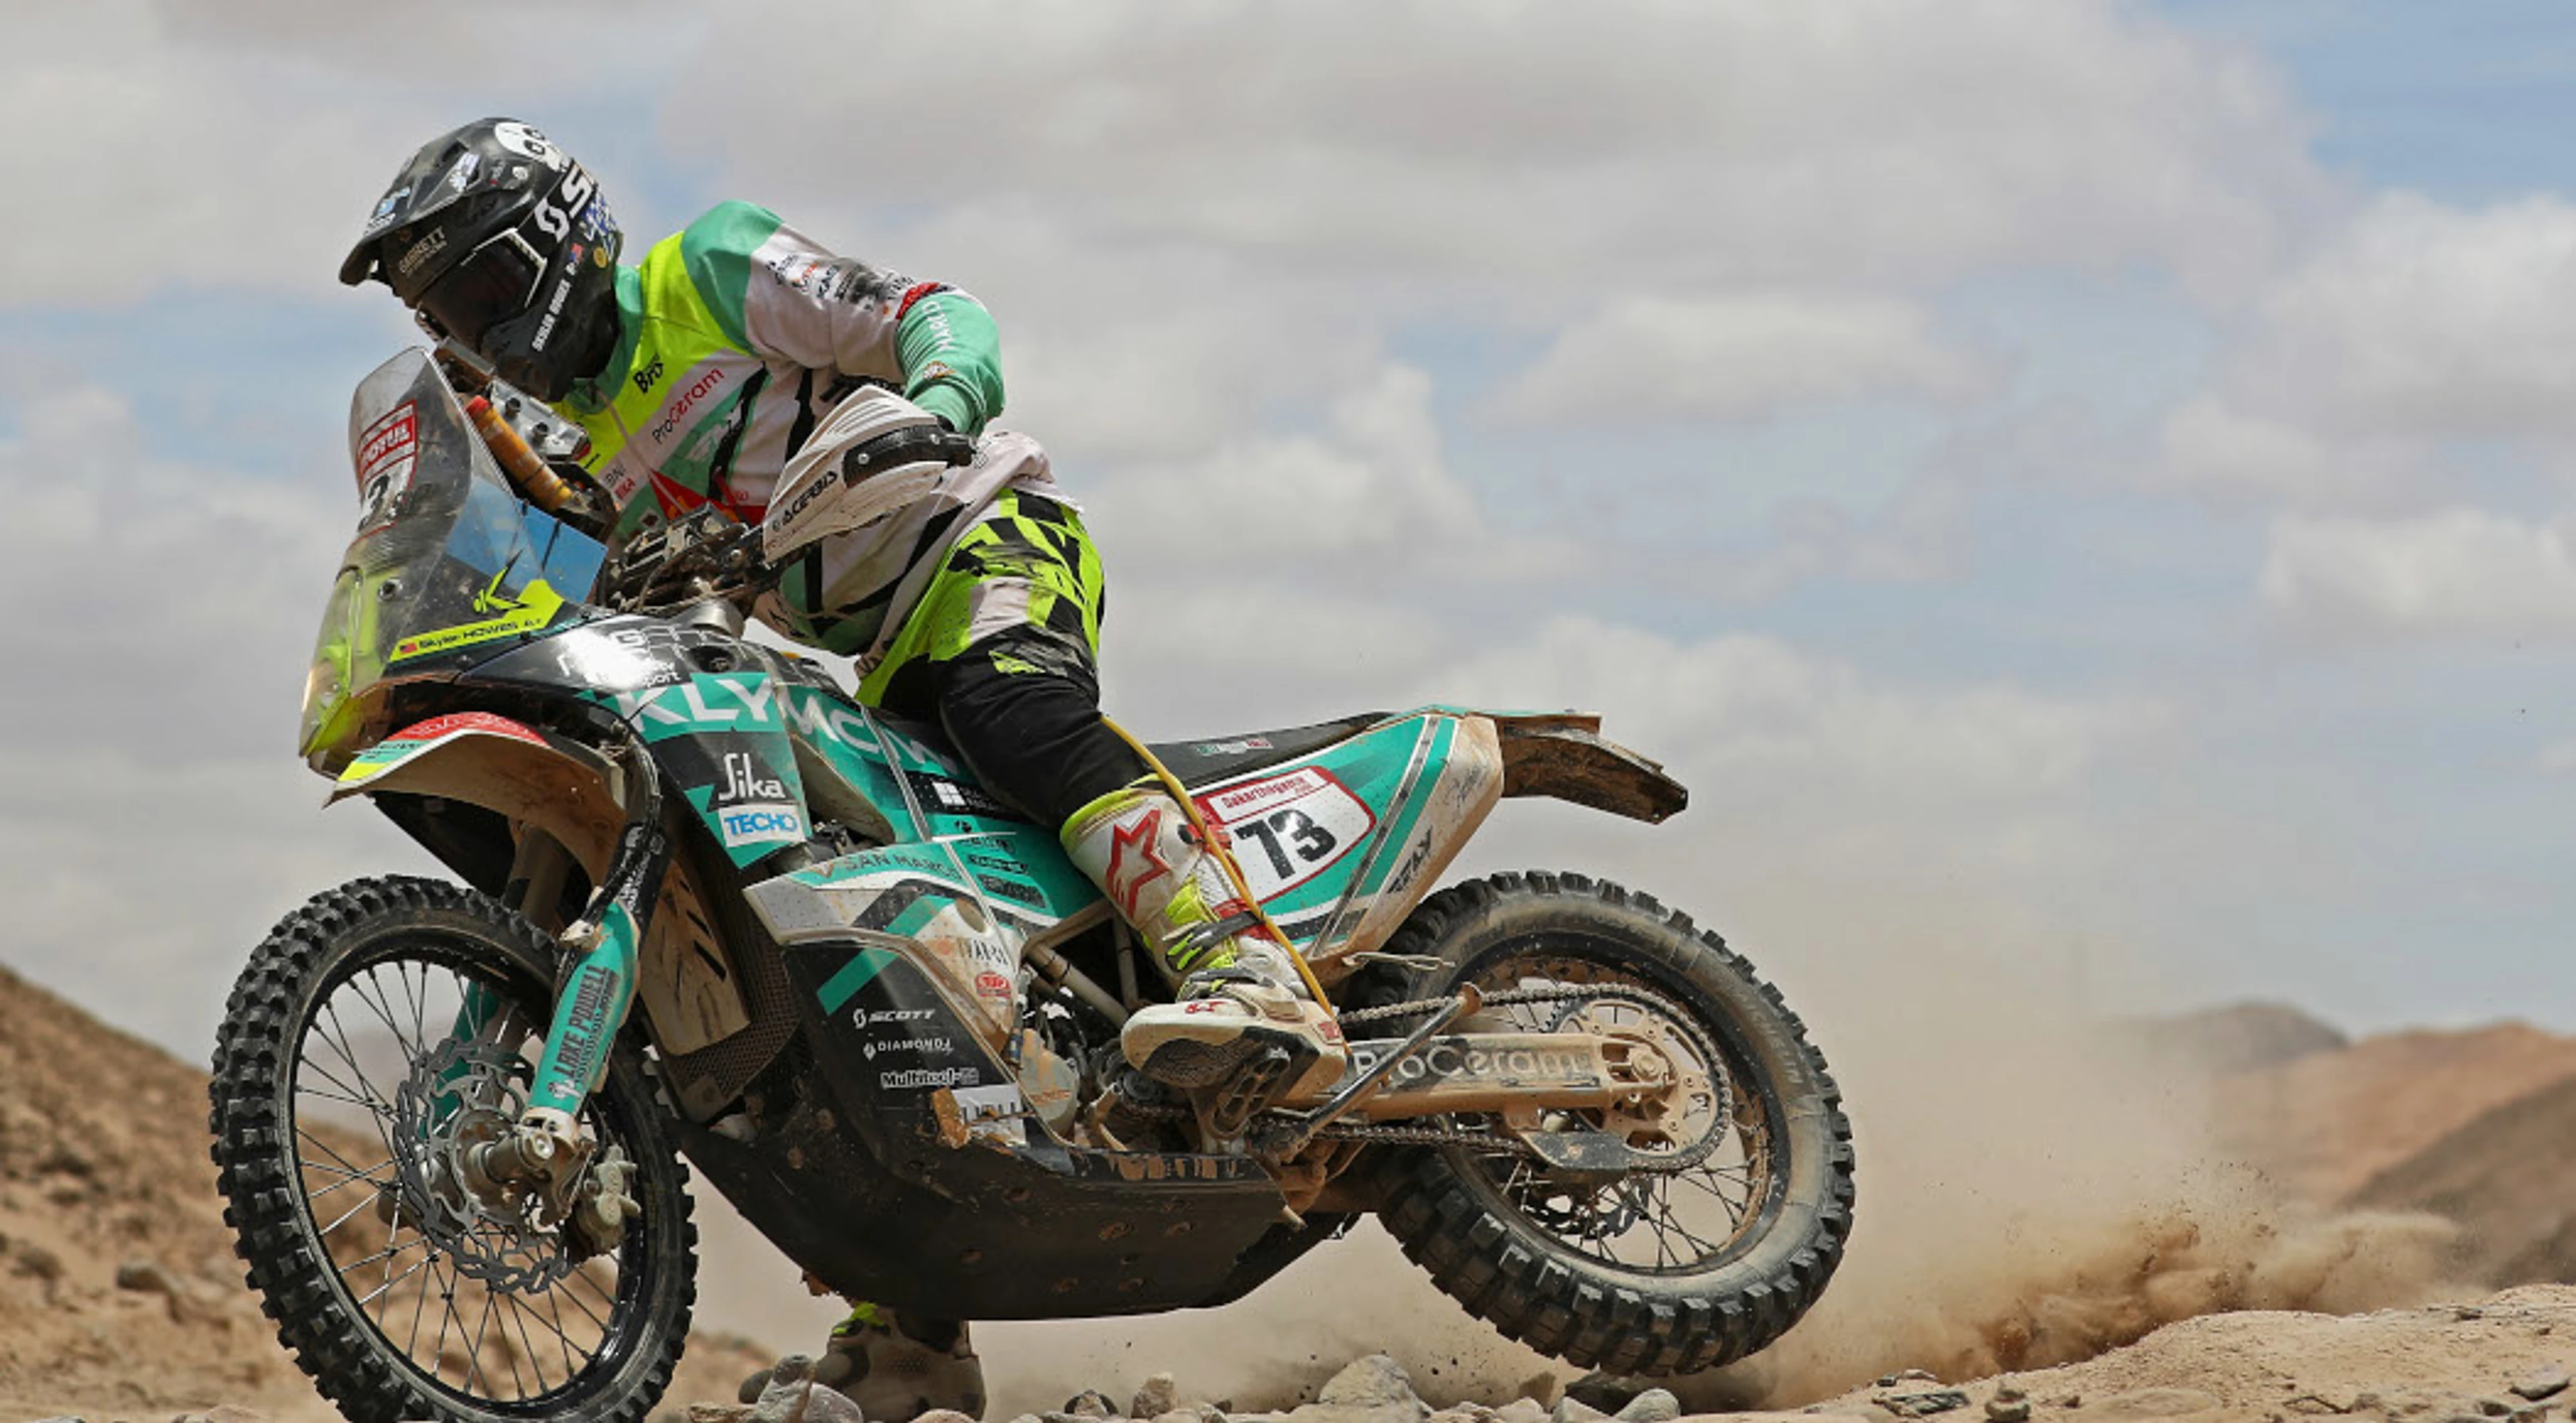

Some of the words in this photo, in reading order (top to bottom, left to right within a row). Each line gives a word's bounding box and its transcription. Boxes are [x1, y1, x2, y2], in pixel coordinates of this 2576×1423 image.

[652, 368, 724, 445] ProCeram
[718, 753, 786, 801] Sika
[1233, 810, 1338, 880] 73
[868, 1008, 936, 1024] SCOTT
[1354, 1044, 1576, 1079] PoCeram
